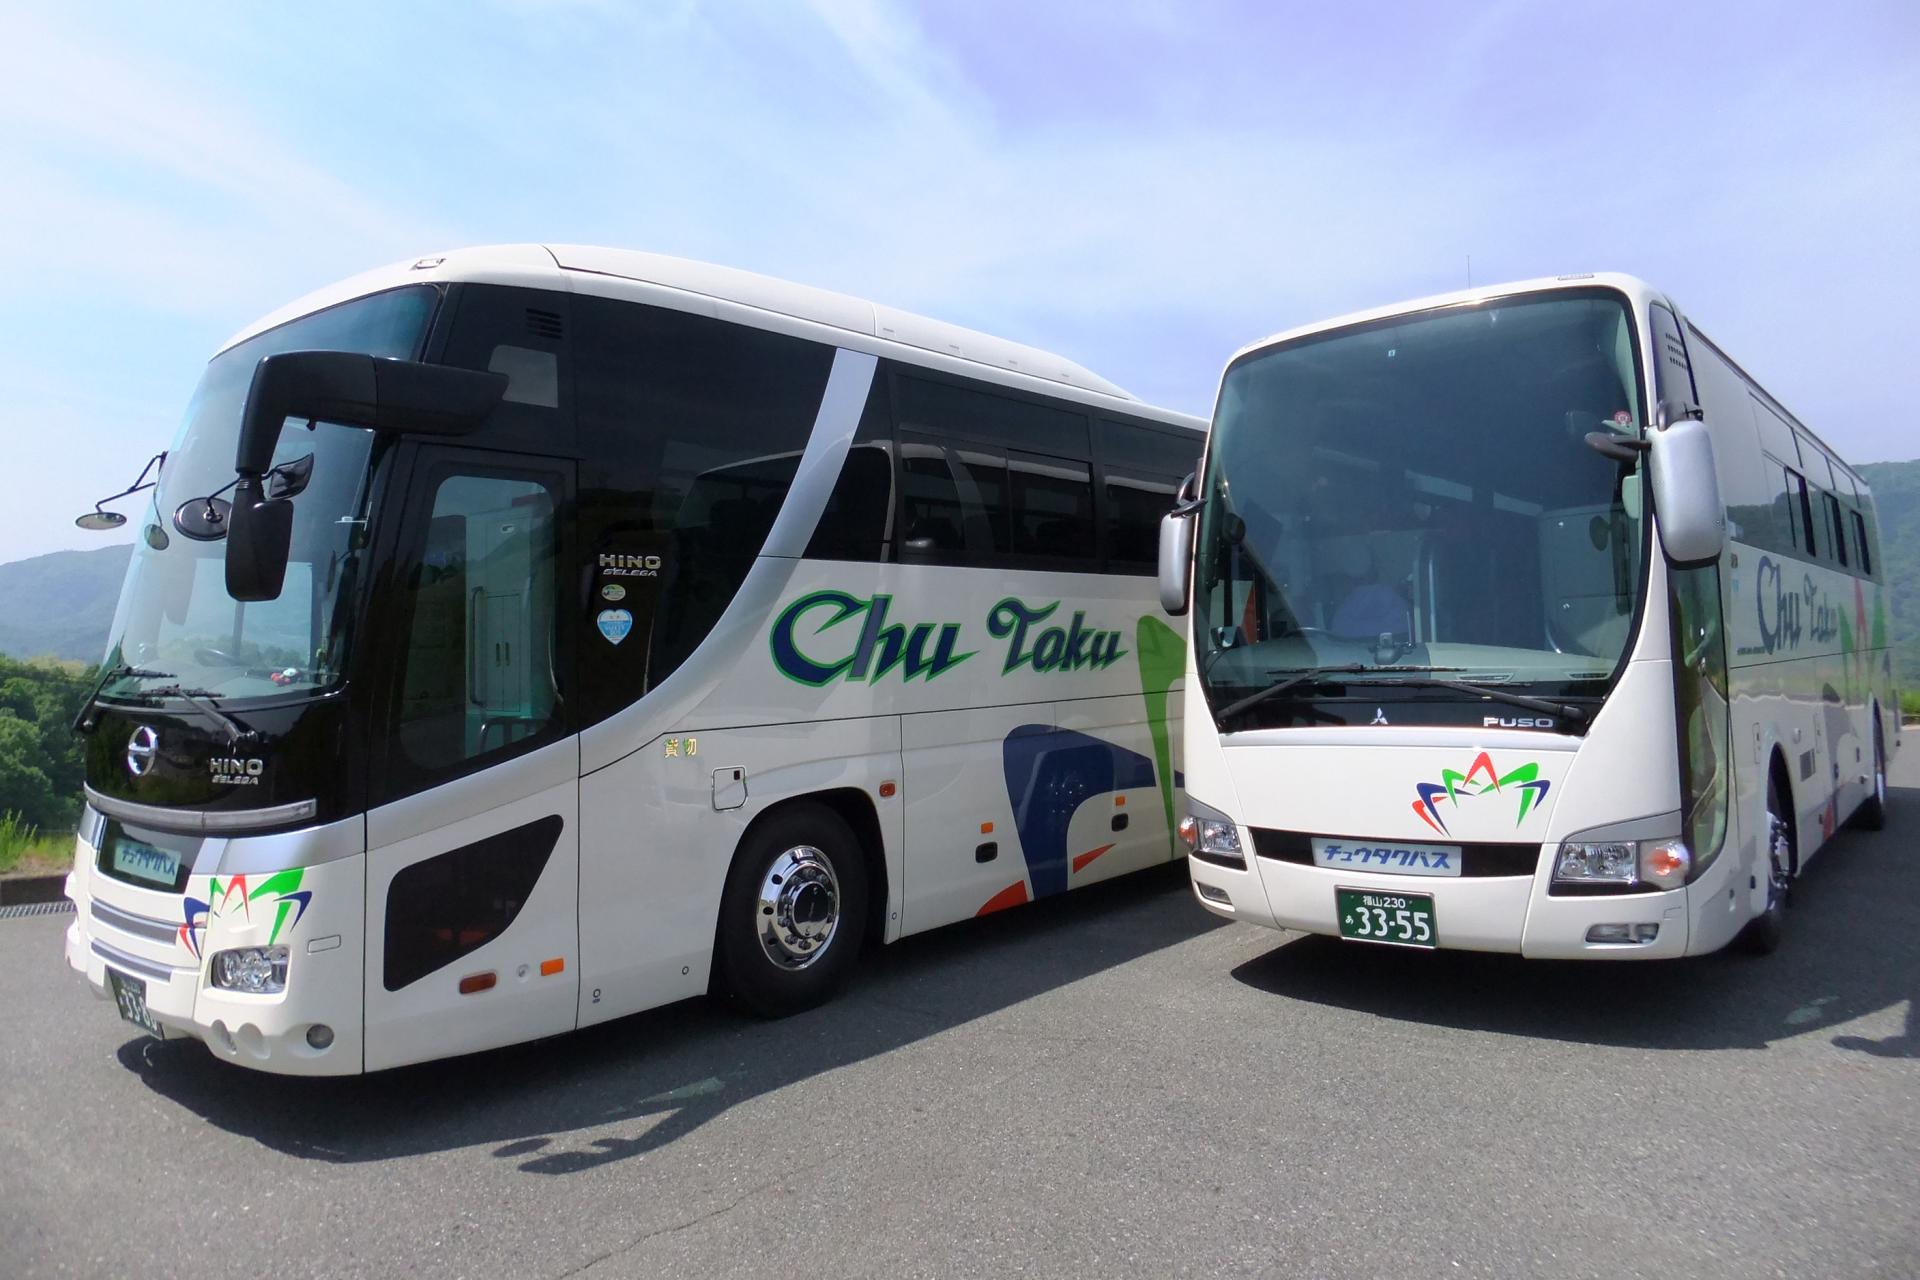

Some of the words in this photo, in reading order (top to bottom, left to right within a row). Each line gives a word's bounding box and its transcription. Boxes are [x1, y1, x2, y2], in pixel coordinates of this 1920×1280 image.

[599, 553, 661, 569] HINO
[603, 567, 657, 577] SELEGA
[1757, 555, 1802, 655] Chu
[769, 589, 980, 687] Chu
[986, 596, 1128, 677] Taku
[1483, 716, 1554, 728] FUSO
[209, 758, 263, 775] HINO
[1323, 845, 1451, 870] チュウタクバス
[1355, 906, 1430, 941] 33-55
